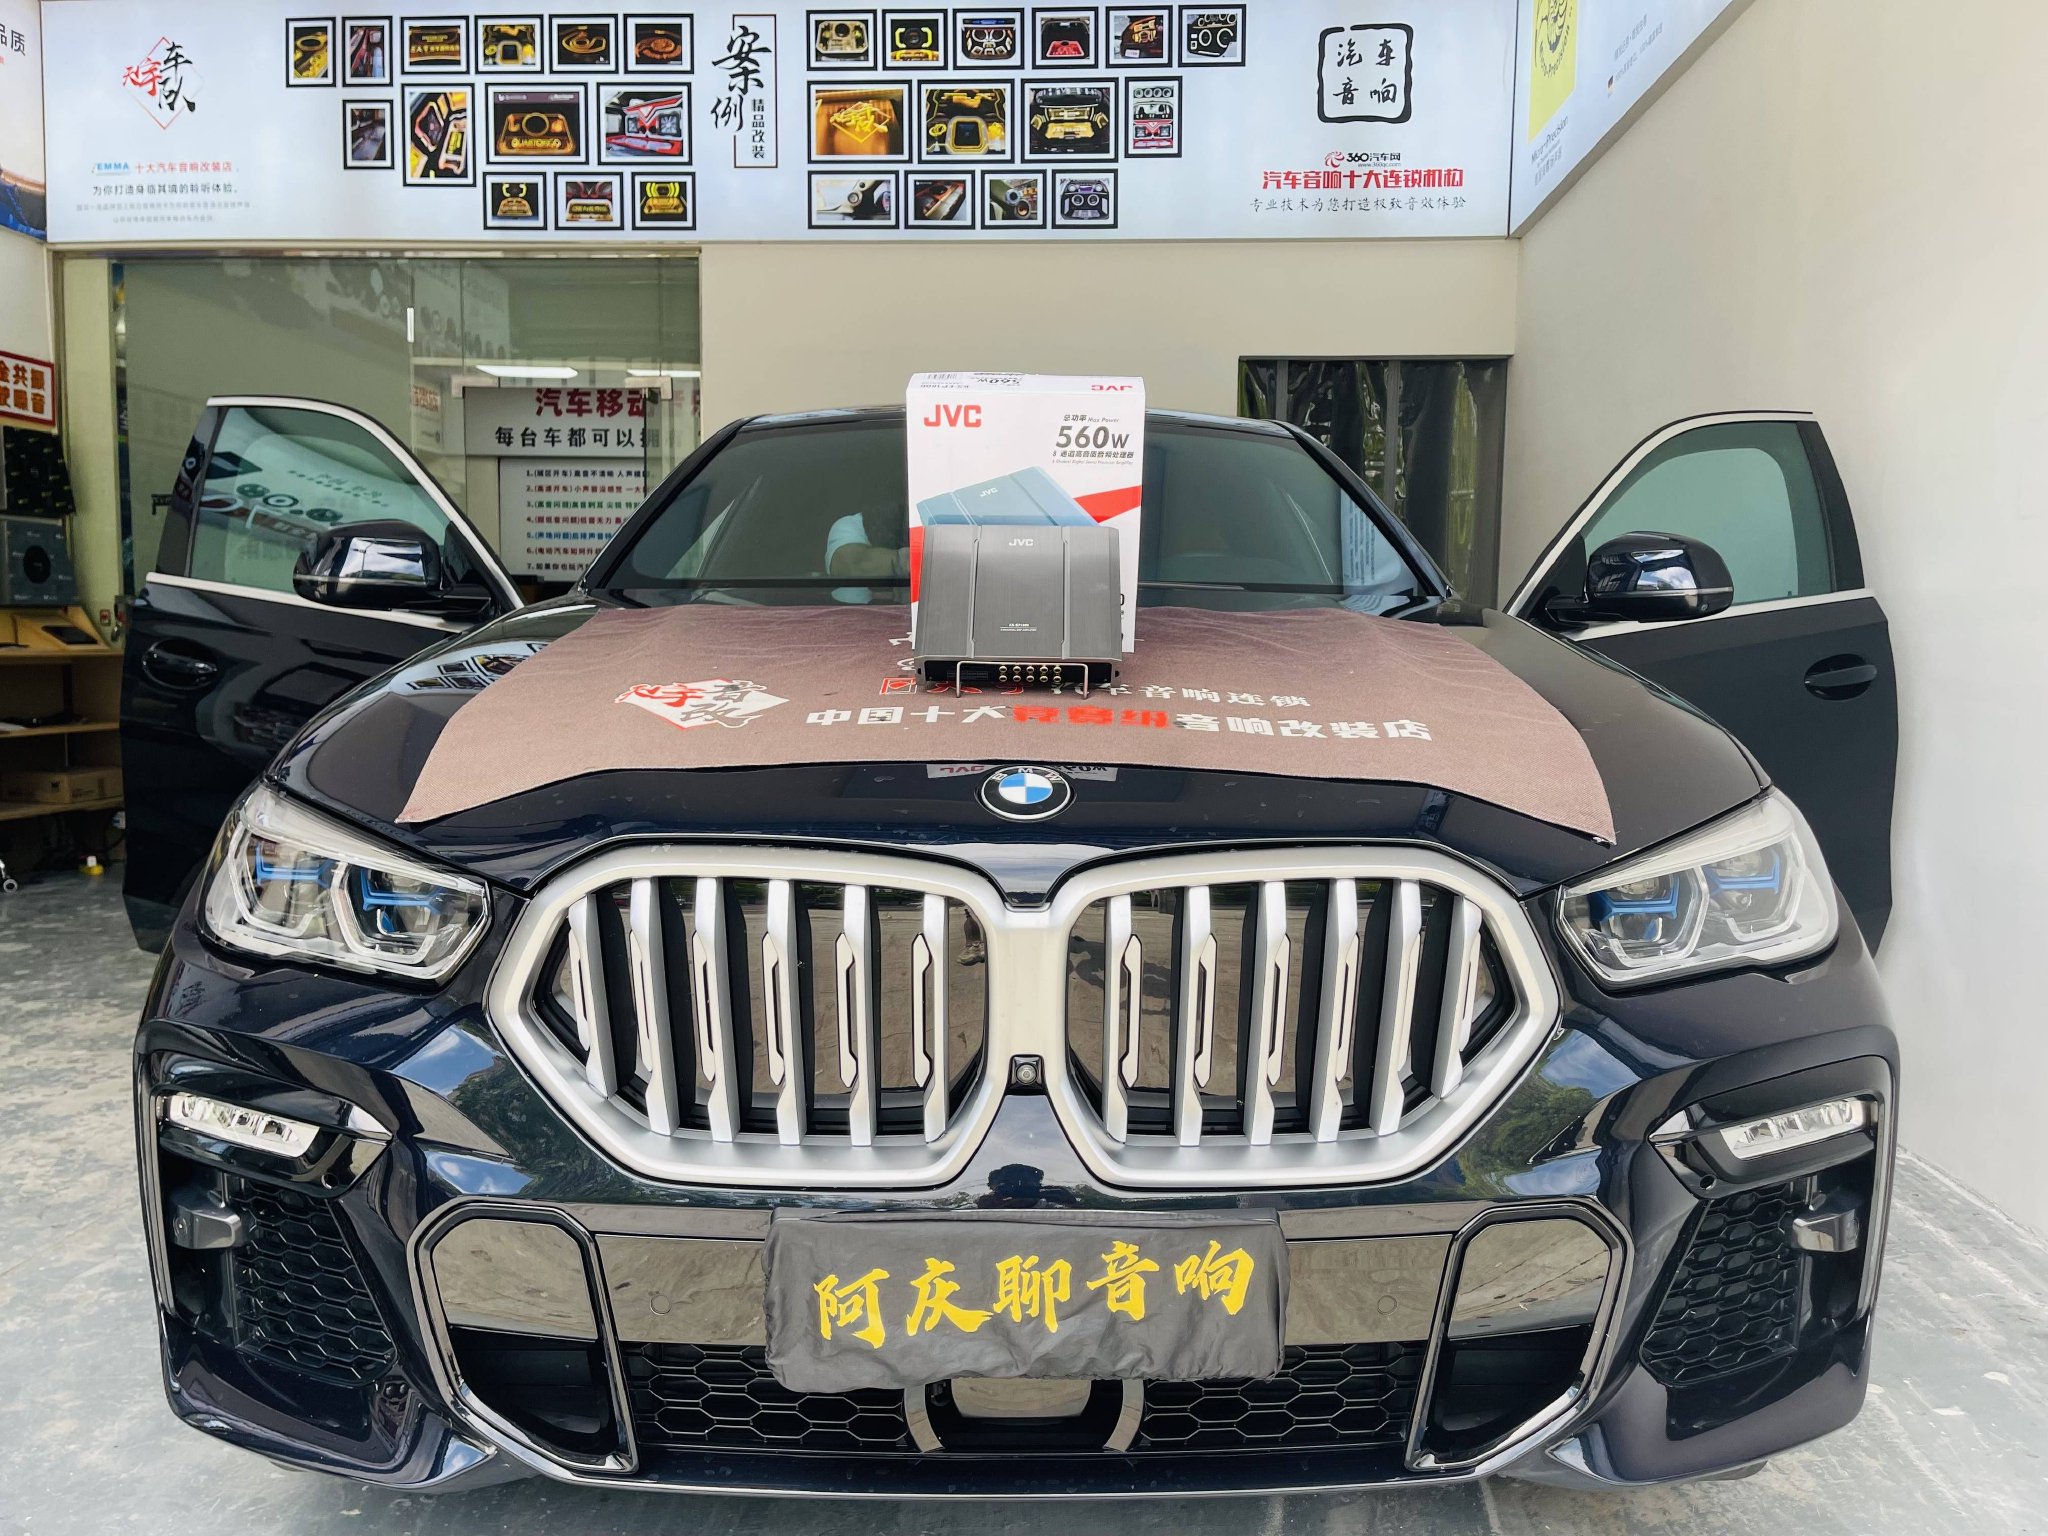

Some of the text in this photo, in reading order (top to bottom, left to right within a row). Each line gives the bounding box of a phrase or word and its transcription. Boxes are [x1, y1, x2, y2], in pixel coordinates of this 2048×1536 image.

[1337, 38, 1396, 68] 汽车
[710, 25, 772, 131] 案例
[1332, 76, 1399, 106] 音响
[752, 98, 765, 159] 精品改装
[96, 161, 130, 171] EMMA
[1346, 152, 1401, 161] 360汽车网
[1262, 168, 1464, 190] 汽车音响十大连锁机构
[1249, 196, 1467, 213] 专业技术为您打造极致音效体验
[923, 404, 982, 428] JVC
[980, 487, 998, 497] JVC
[1009, 539, 1034, 547] JVC
[991, 766, 1061, 783] BMW
[814, 1240, 1254, 1349] 阿庆聊音响
